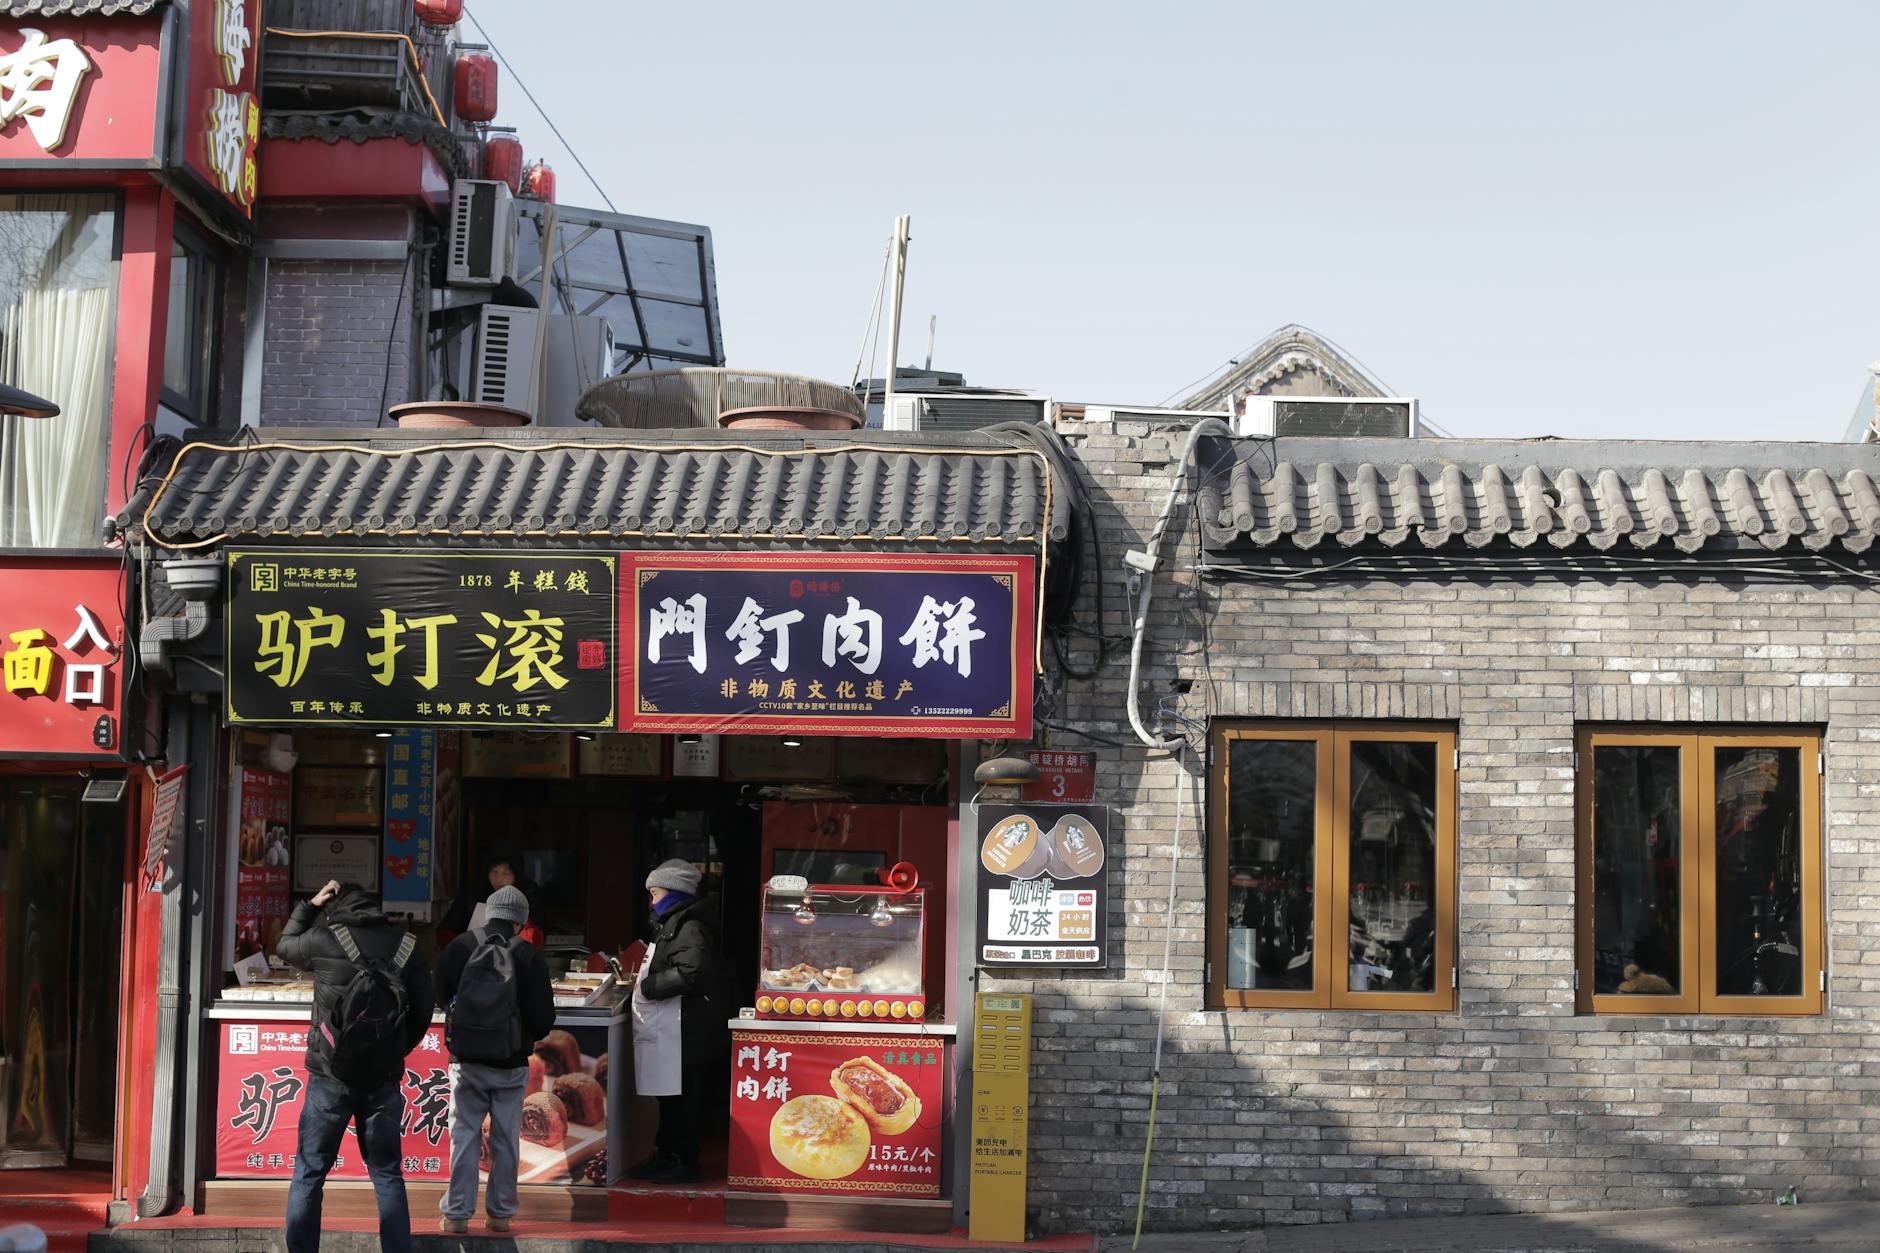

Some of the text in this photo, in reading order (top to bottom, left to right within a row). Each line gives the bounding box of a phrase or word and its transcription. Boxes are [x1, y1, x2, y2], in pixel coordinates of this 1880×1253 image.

[283, 567, 357, 581] 中华老字号
[459, 569, 591, 595] 1878 年糕錢
[646, 592, 987, 678] 門釘肉餅
[63, 604, 110, 704] 入口
[253, 605, 571, 693] 驴打滚
[3, 627, 55, 695] 面
[719, 678, 915, 701] 非物质文化遗产
[290, 699, 365, 715] 百年传承
[416, 701, 553, 717] 非物质文化遗产
[924, 707, 973, 715] 13522229999
[1030, 753, 1089, 767] 银锭桥胡同
[1052, 774, 1065, 797] 3
[1009, 878, 1054, 907] 咖啡
[1078, 895, 1092, 903] 热饮
[1007, 908, 1053, 936] 奶茶
[737, 1045, 792, 1072] 門釘
[883, 1051, 937, 1065] 清真食品
[736, 1074, 792, 1102] 肉餅
[870, 1144, 936, 1163] 15元/个
